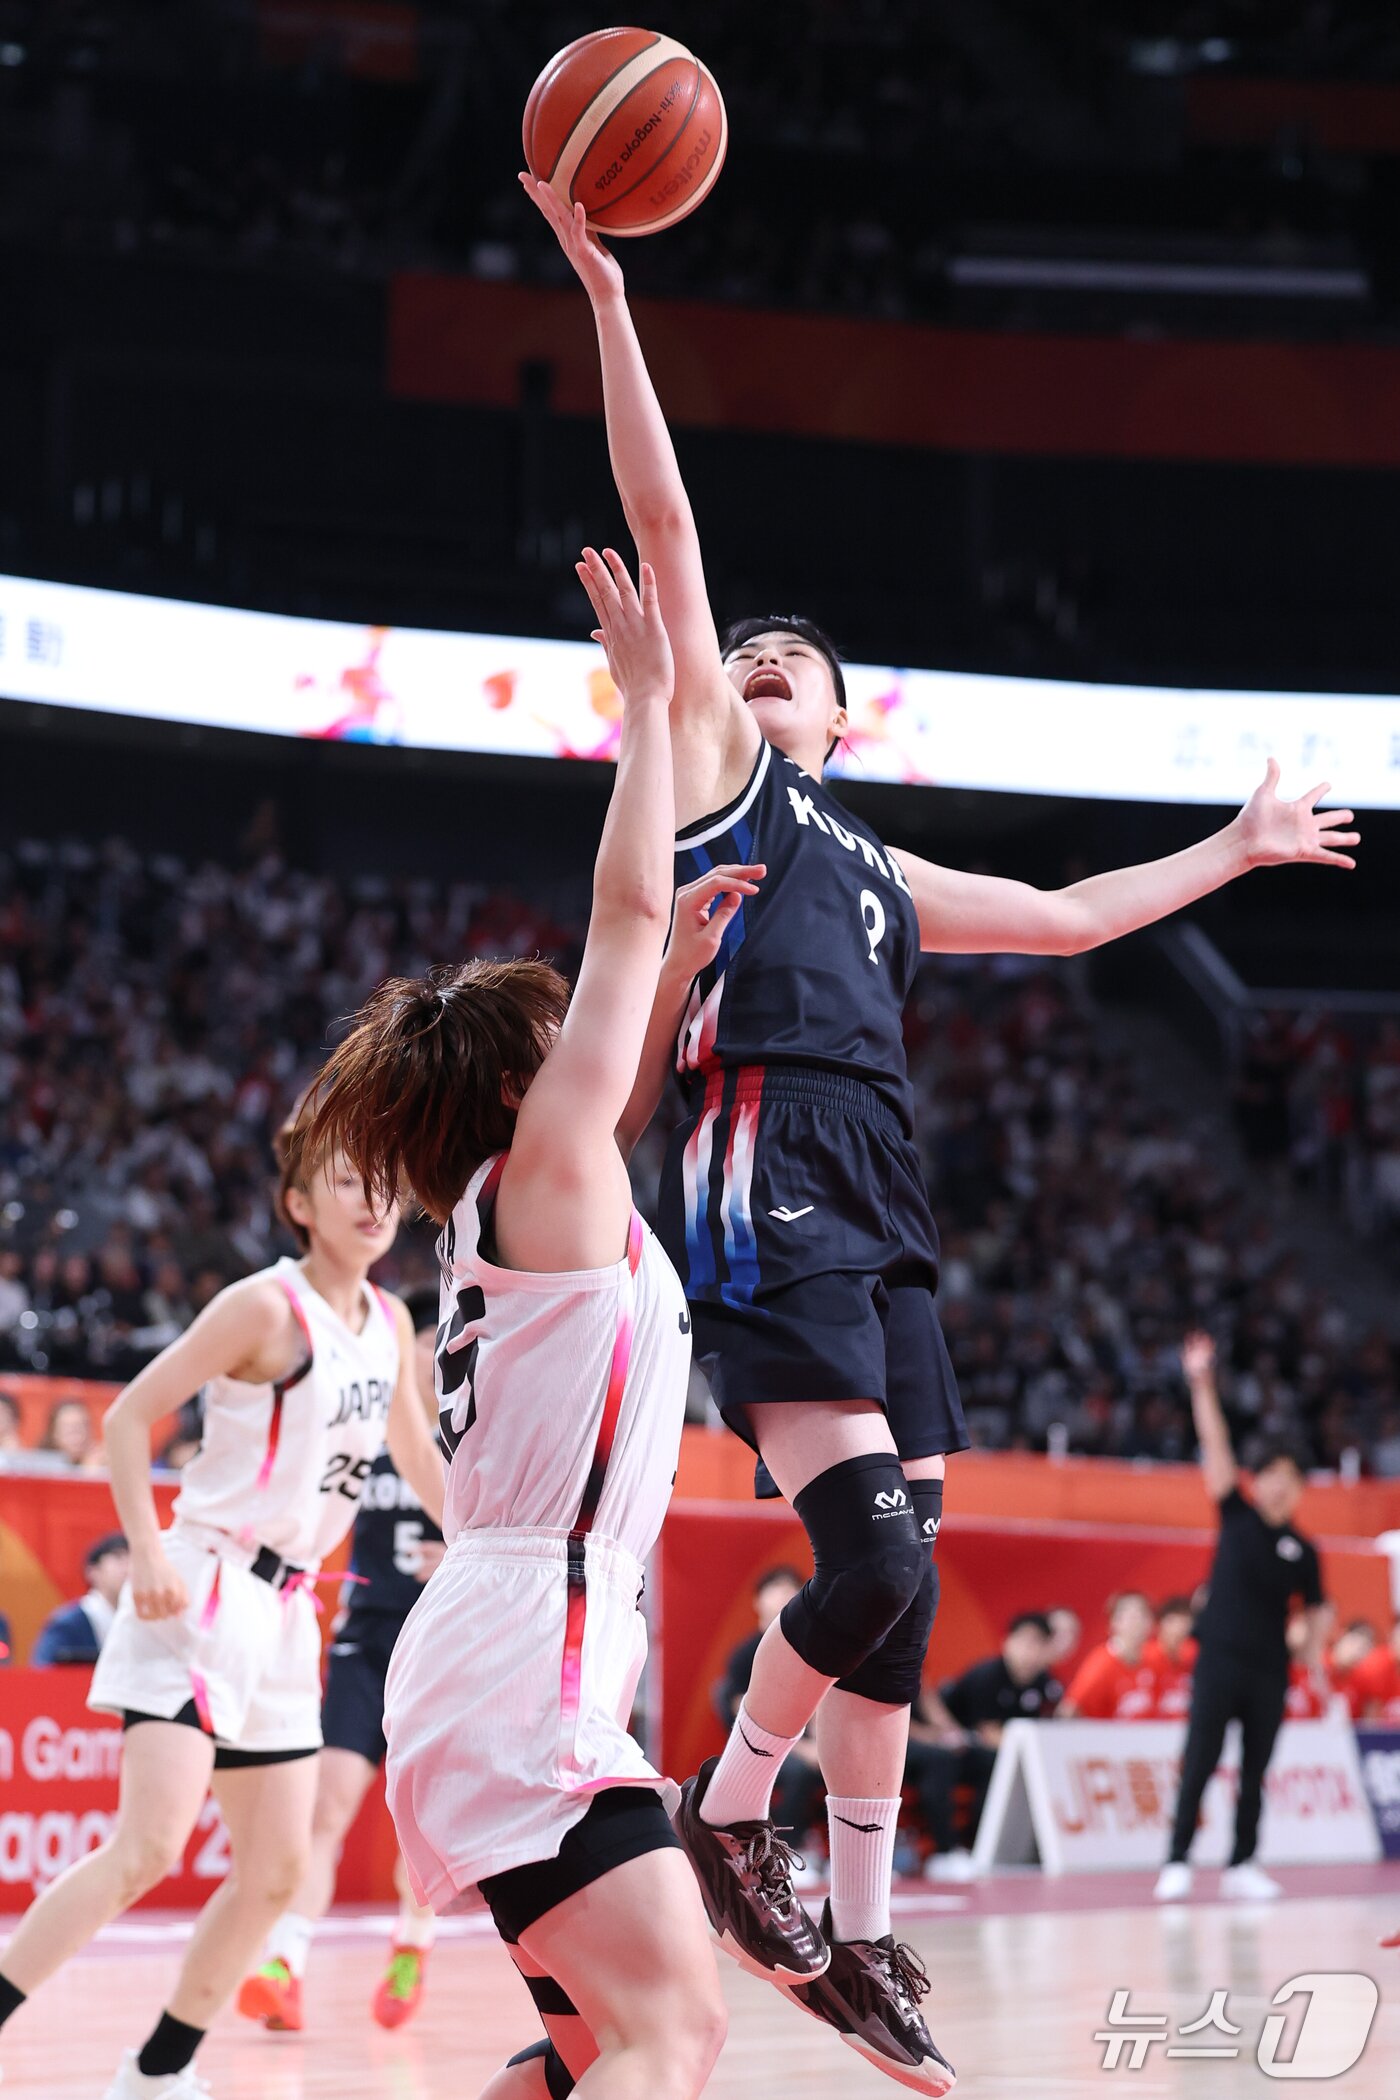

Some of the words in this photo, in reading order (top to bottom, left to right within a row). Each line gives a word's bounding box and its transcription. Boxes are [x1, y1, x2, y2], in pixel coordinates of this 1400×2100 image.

[594, 161, 624, 190] 2026
[651, 129, 711, 205] molten
[319, 1453, 372, 1500] 25
[393, 1520, 424, 1575] 5
